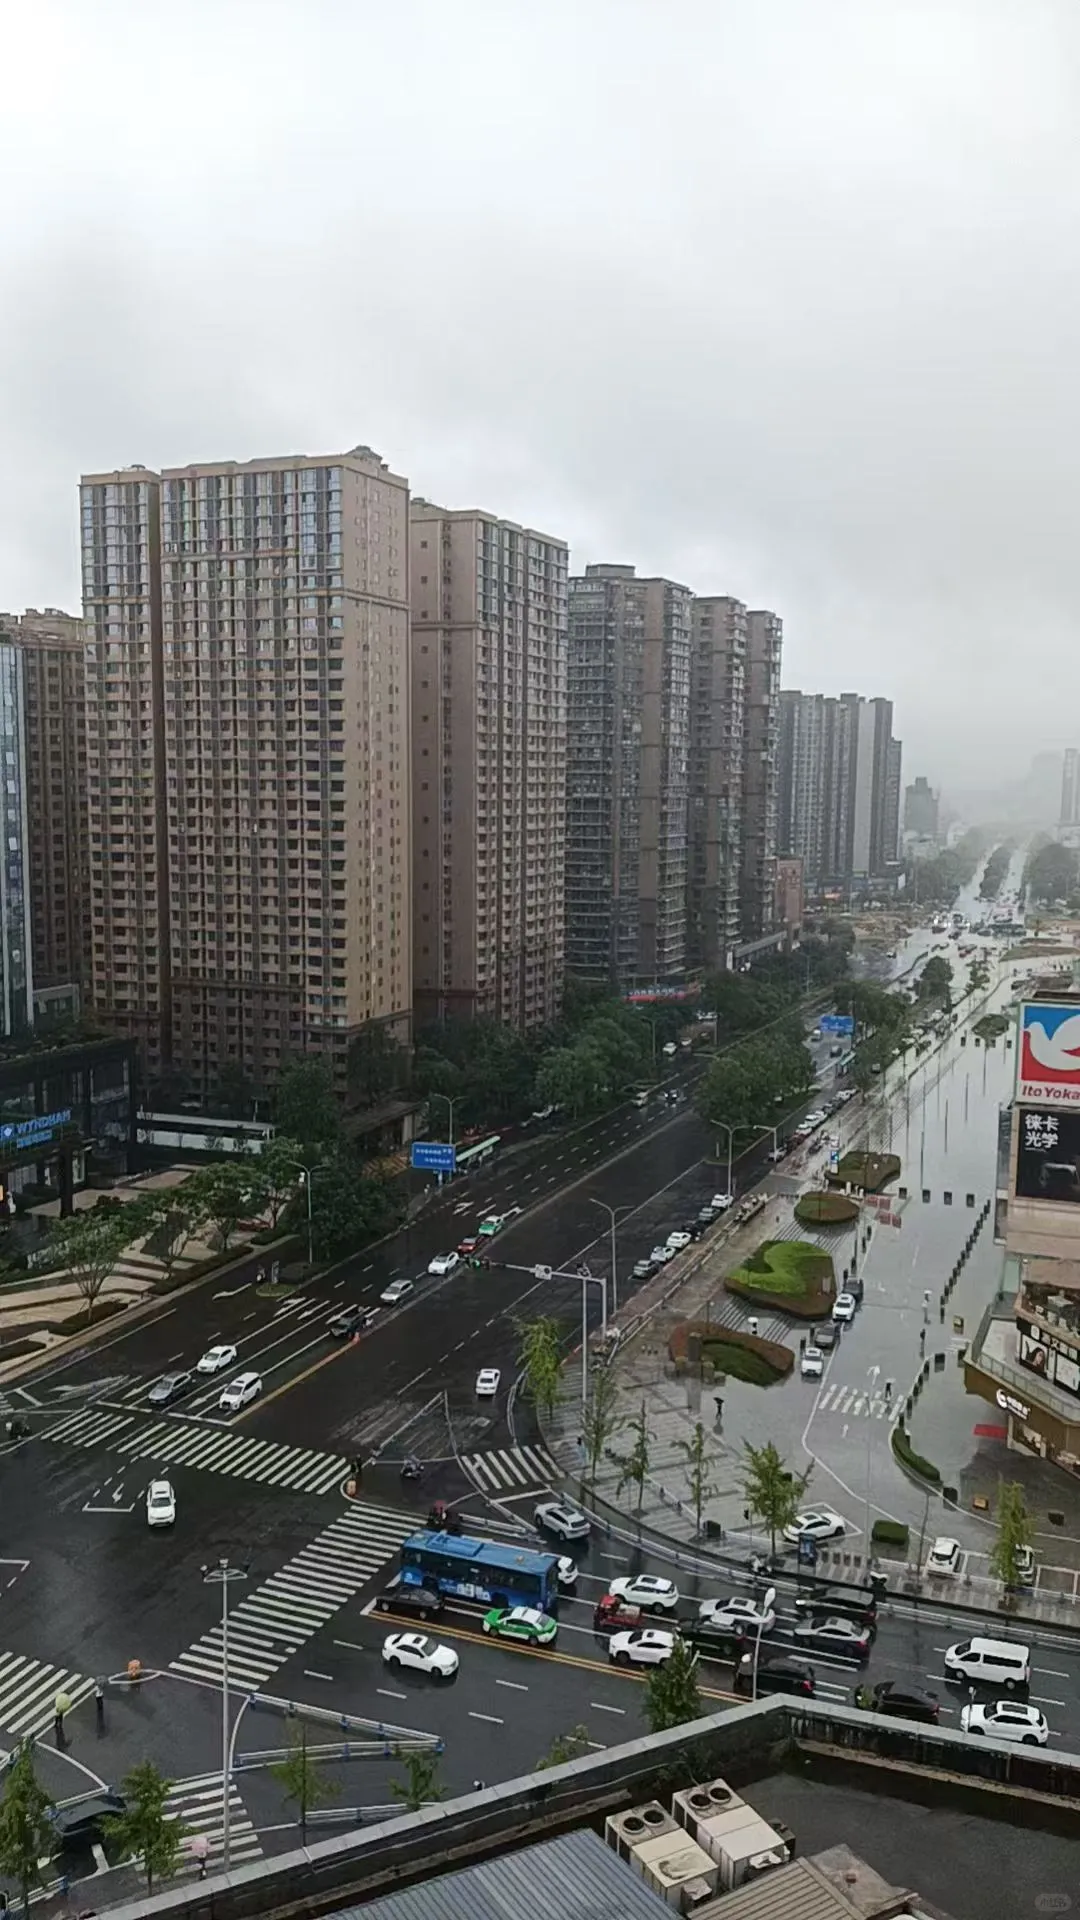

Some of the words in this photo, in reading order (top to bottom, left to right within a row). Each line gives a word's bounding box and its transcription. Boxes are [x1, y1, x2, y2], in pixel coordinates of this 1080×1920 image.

[1022, 1085, 1043, 1098] Ito
[16, 1109, 71, 1134] WYNDHAM
[1025, 1131, 1059, 1149] 光学
